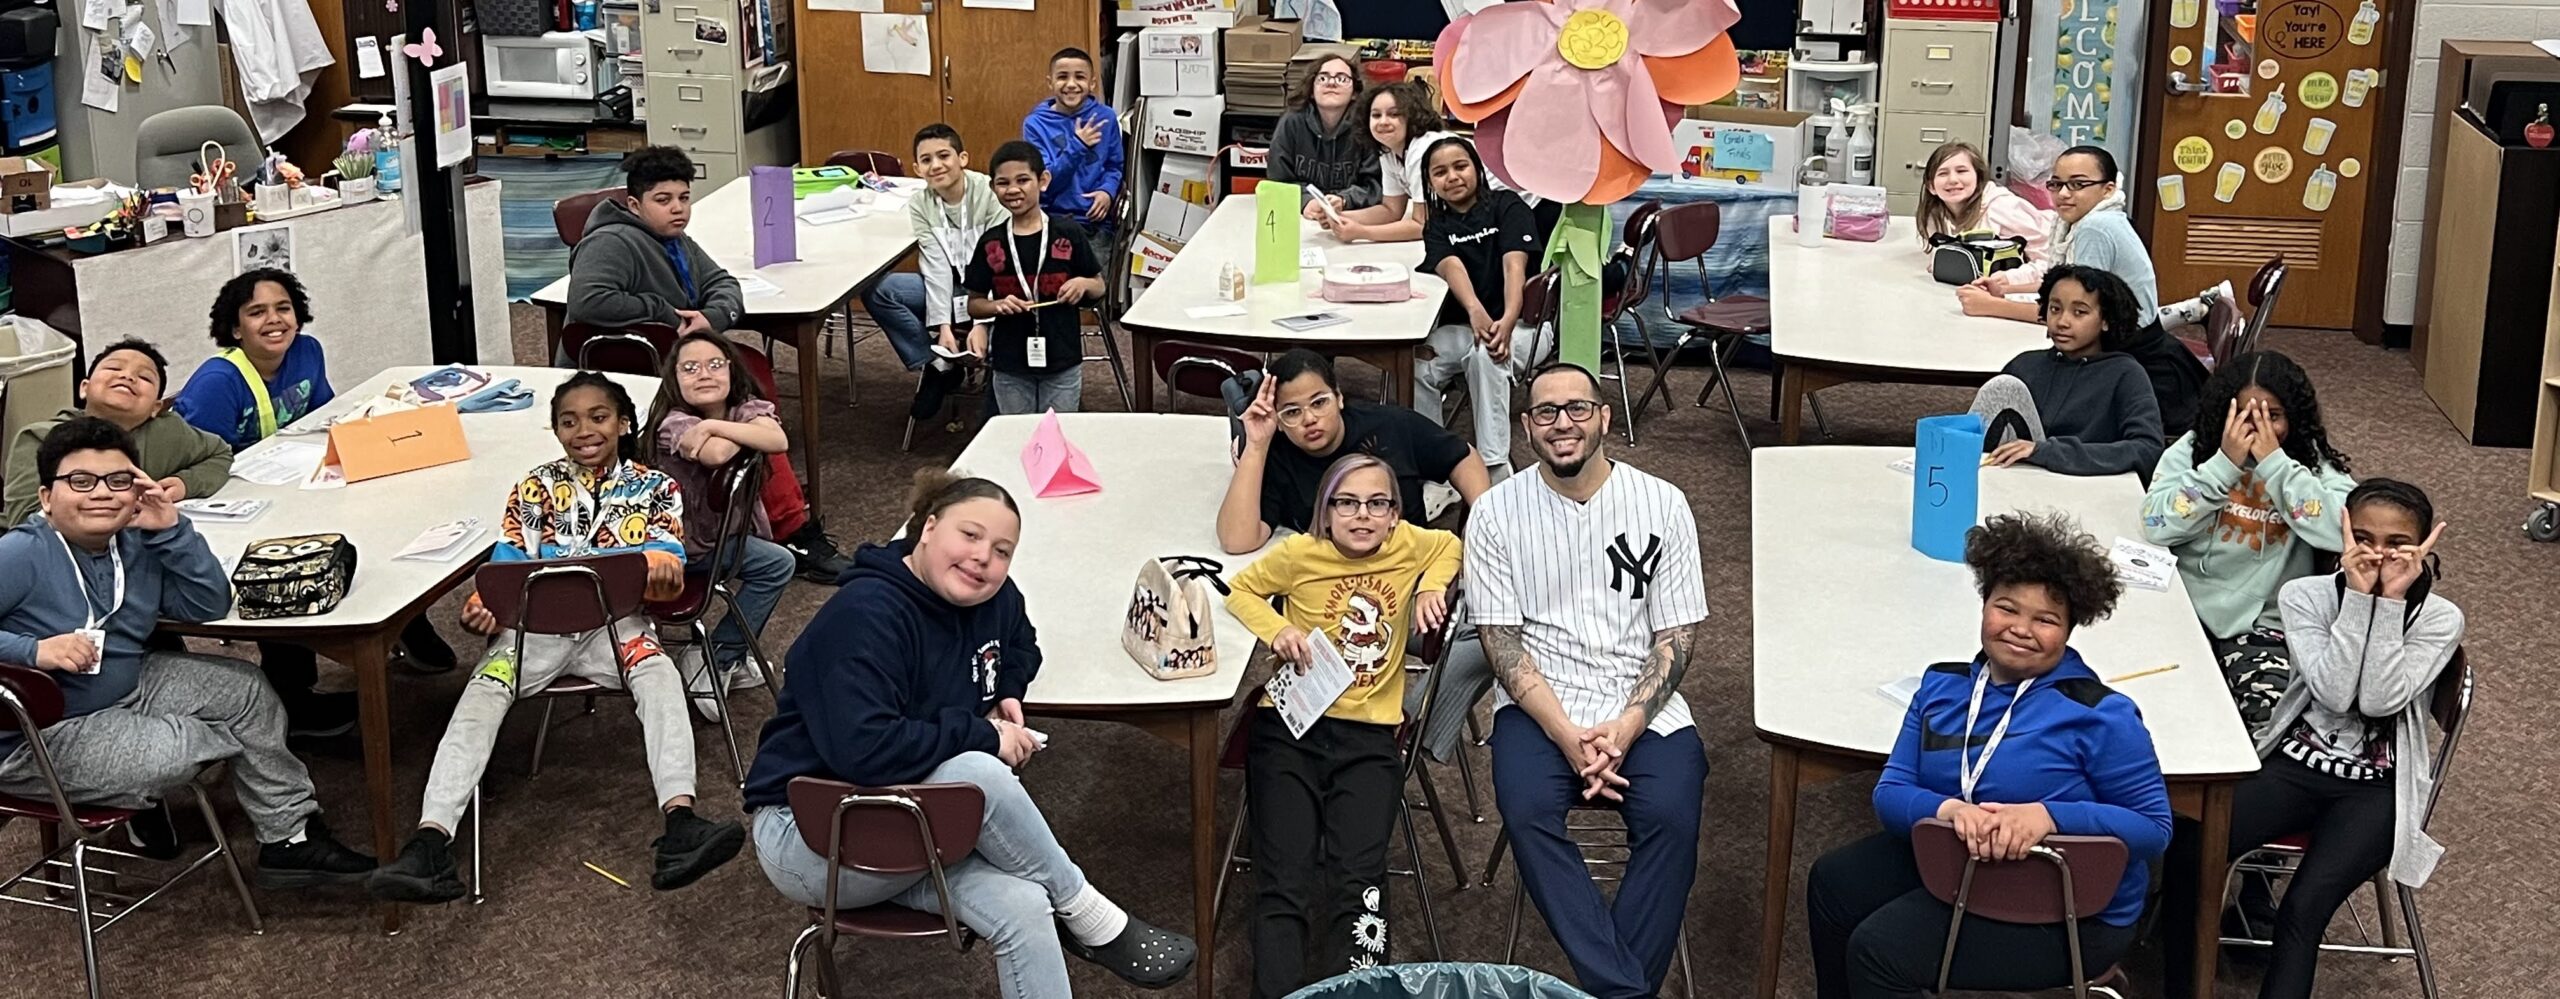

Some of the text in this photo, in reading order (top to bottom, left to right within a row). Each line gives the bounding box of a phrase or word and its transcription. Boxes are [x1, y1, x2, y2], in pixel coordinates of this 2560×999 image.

[2293, 4, 2320, 17] Yay!
[2285, 20, 2327, 32] You're
[2294, 36, 2326, 48] HERE
[1747, 134, 1754, 145] 3
[2179, 144, 2208, 156] Think
[2261, 160, 2284, 174] give
[763, 195, 775, 228] 2
[1265, 209, 1276, 243] 4
[386, 429, 423, 447] 1
[1032, 442, 1043, 468] 3
[1928, 466, 1949, 508] 5
[1605, 531, 1663, 600] NY
